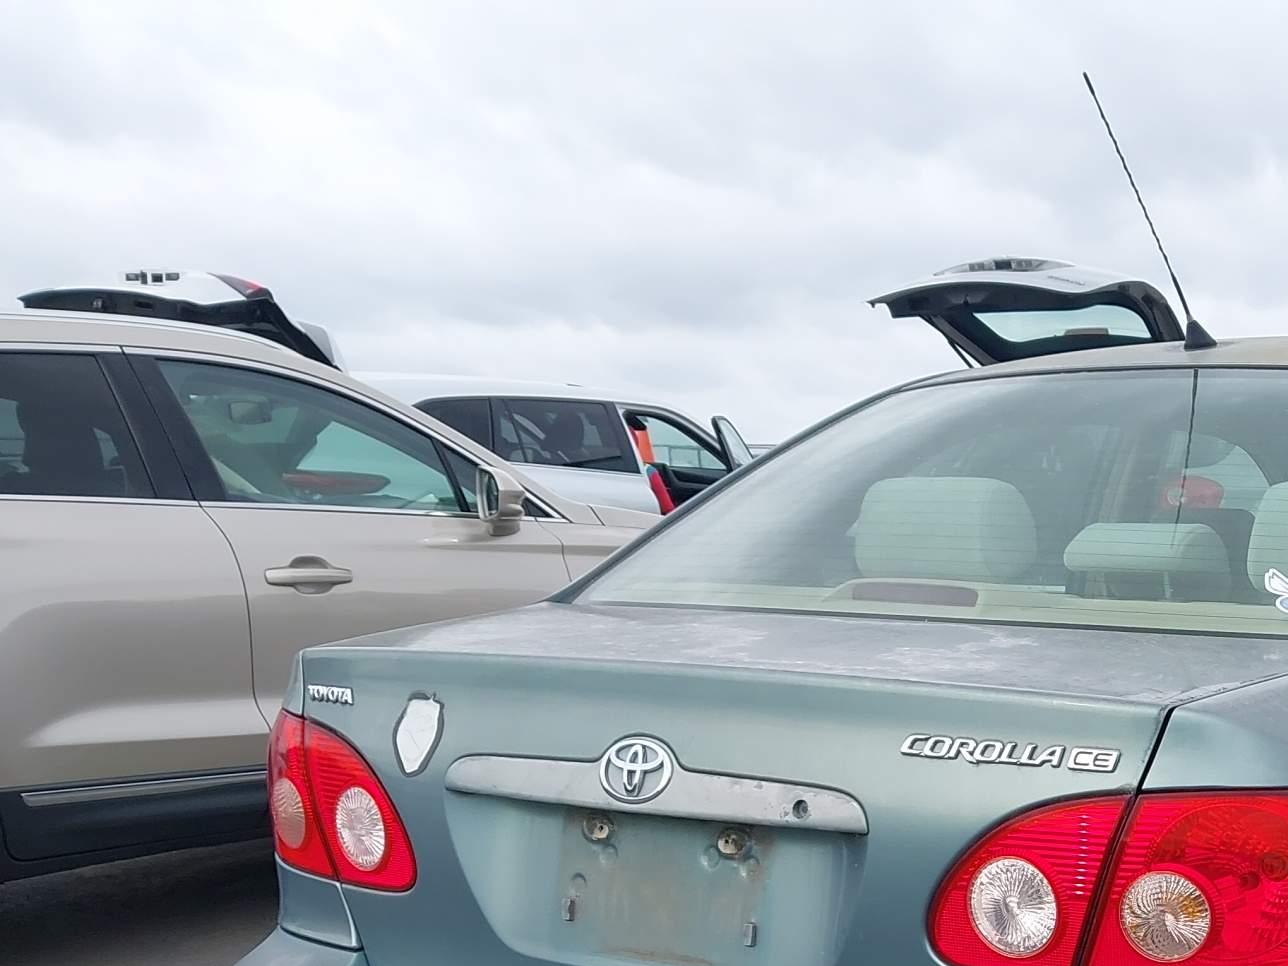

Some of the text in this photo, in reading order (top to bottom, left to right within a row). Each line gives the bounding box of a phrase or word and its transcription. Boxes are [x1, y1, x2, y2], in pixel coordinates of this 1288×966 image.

[308, 684, 354, 705] TOYOTA
[900, 733, 1117, 770] COROLLA CE
